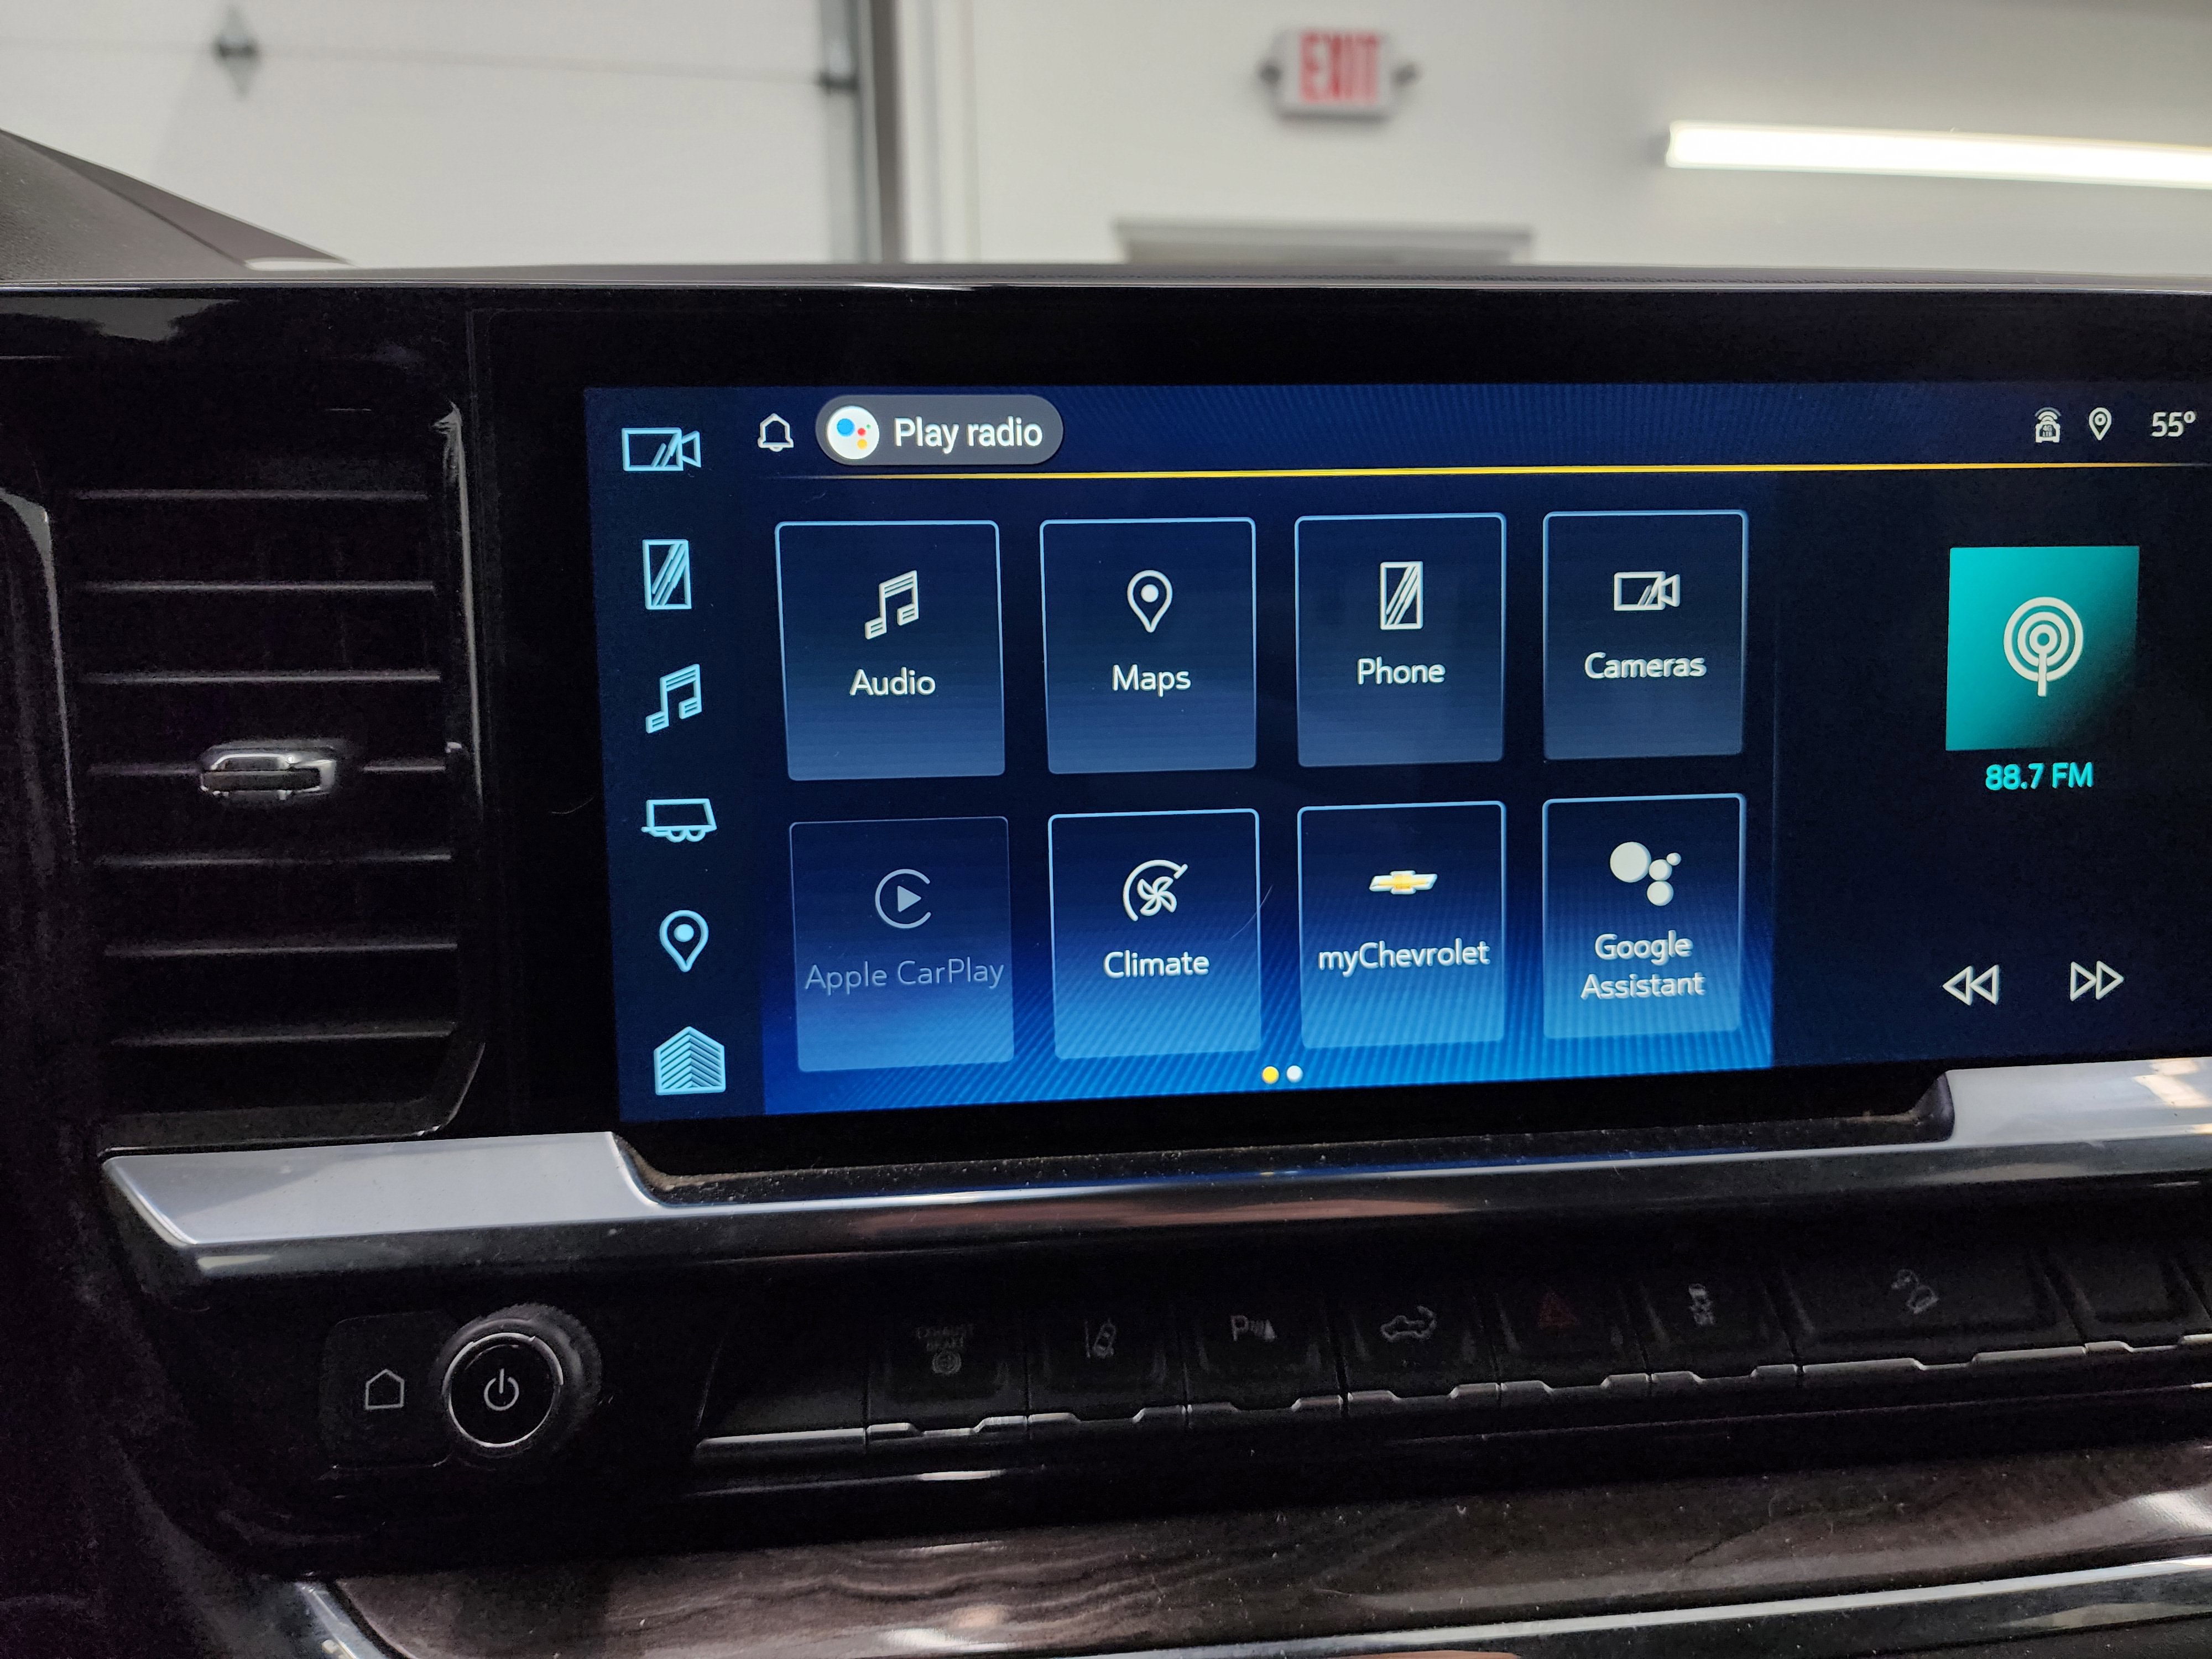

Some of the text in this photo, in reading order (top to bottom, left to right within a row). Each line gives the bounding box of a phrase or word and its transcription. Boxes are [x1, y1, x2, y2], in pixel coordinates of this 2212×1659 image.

[1300, 32, 1379, 103] EXIT
[895, 416, 1042, 454] Play radio
[1113, 664, 1191, 697] Maps
[1358, 656, 1445, 685] Phone
[1585, 652, 1706, 679] Cameras
[849, 667, 936, 696] Audio
[1986, 762, 2093, 790] 88.7 FM
[1319, 938, 1490, 977] myChevrolet
[1595, 930, 1693, 965] Google
[805, 957, 1005, 995] Apple CarPlay
[1104, 950, 1209, 978] Climate
[1580, 972, 1705, 999] Assistant
